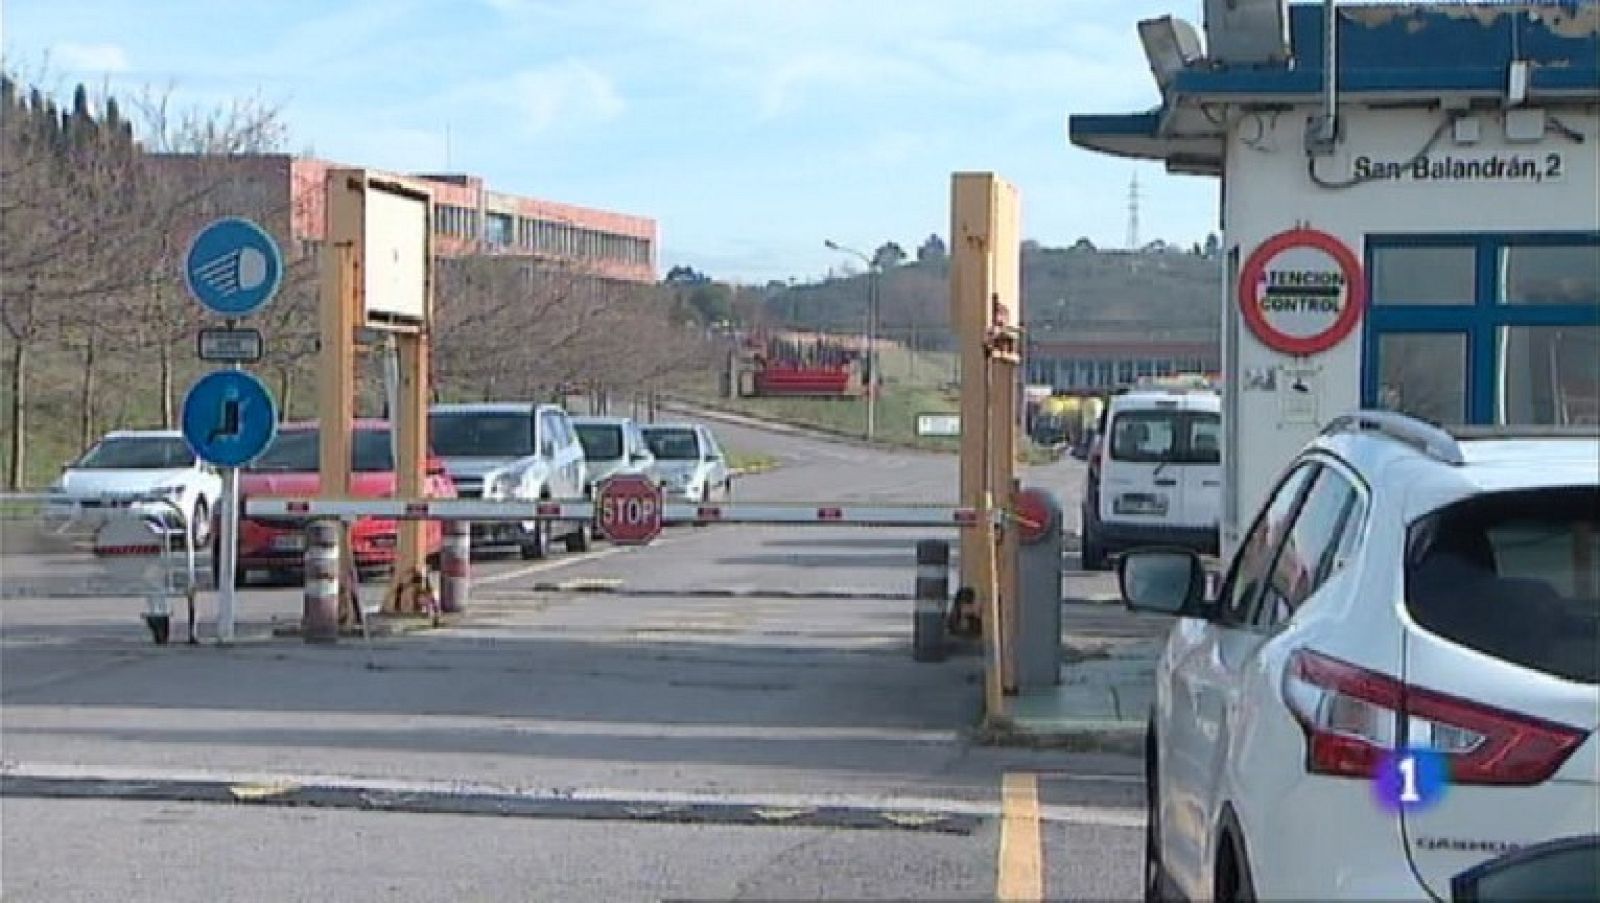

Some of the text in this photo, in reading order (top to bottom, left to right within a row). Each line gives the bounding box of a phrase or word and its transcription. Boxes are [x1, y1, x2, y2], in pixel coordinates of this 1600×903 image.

[1353, 156, 1400, 180] San
[1545, 153, 1561, 177] 2
[1261, 298, 1339, 313] CONTROL
[602, 496, 656, 525] STOP
